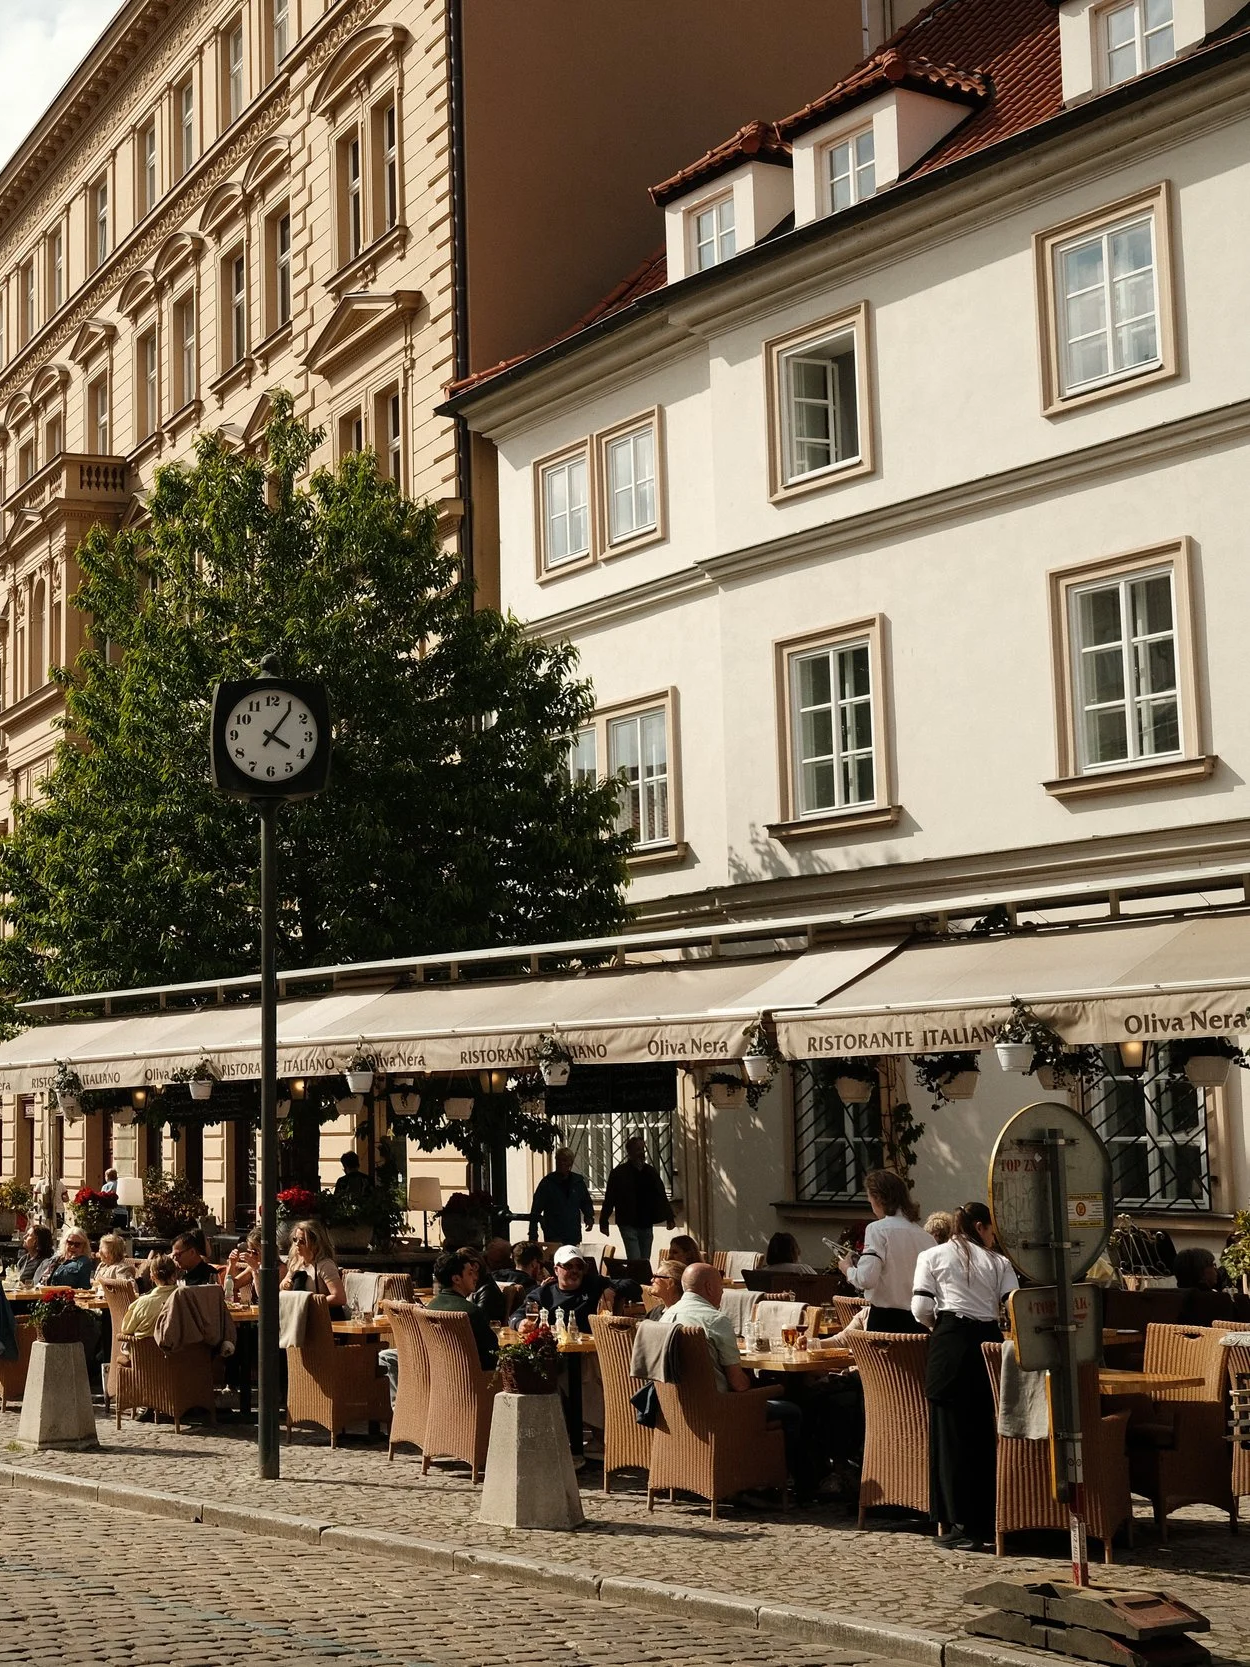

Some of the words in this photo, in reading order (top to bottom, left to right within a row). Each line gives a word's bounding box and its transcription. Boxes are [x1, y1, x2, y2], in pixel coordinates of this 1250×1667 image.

[248, 701, 260, 712] 11
[265, 695, 280, 707] 12
[236, 714, 251, 725] 10
[299, 713, 308, 724] 2
[230, 730, 239, 741] 9
[304, 731, 313, 742] 3
[235, 748, 244, 759] 8
[296, 748, 306, 759] 4
[249, 761, 257, 773] 7
[266, 766, 275, 777] 6
[285, 762, 293, 773] 5
[1124, 1013, 1185, 1034] Oliva
[1190, 1010, 1247, 1030] Nera
[807, 1031, 914, 1051] RISTORANTE
[923, 1025, 1001, 1046] ITALIAN
[647, 1040, 687, 1056] Oliva
[690, 1038, 729, 1054] Nera
[366, 1053, 397, 1067] Oliva
[398, 1052, 426, 1067] Nera
[222, 1063, 278, 1076] RISTORA
[283, 1058, 335, 1072] ITALIANO
[144, 1067, 170, 1081] Oliva
[31, 1076, 55, 1089] RISTO
[83, 1072, 120, 1085] ITALIANO
